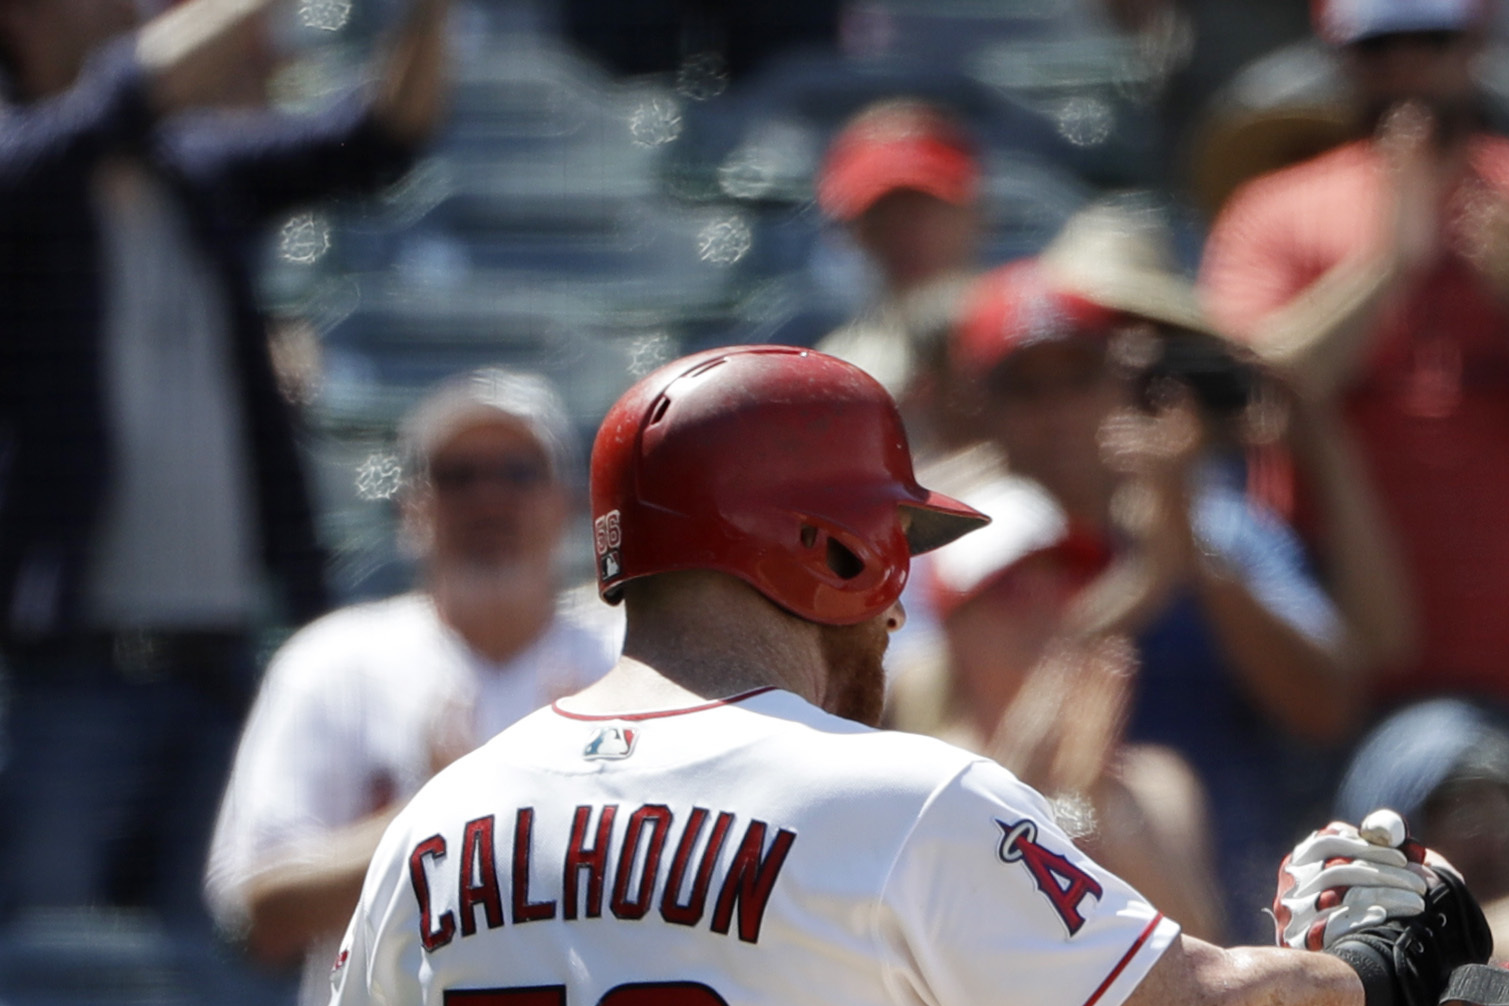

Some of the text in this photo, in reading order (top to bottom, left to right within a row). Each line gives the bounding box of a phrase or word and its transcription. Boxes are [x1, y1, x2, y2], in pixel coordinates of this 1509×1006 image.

[594, 509, 621, 556] 56
[409, 803, 797, 953] CALHOUN
[994, 818, 1104, 938] A
